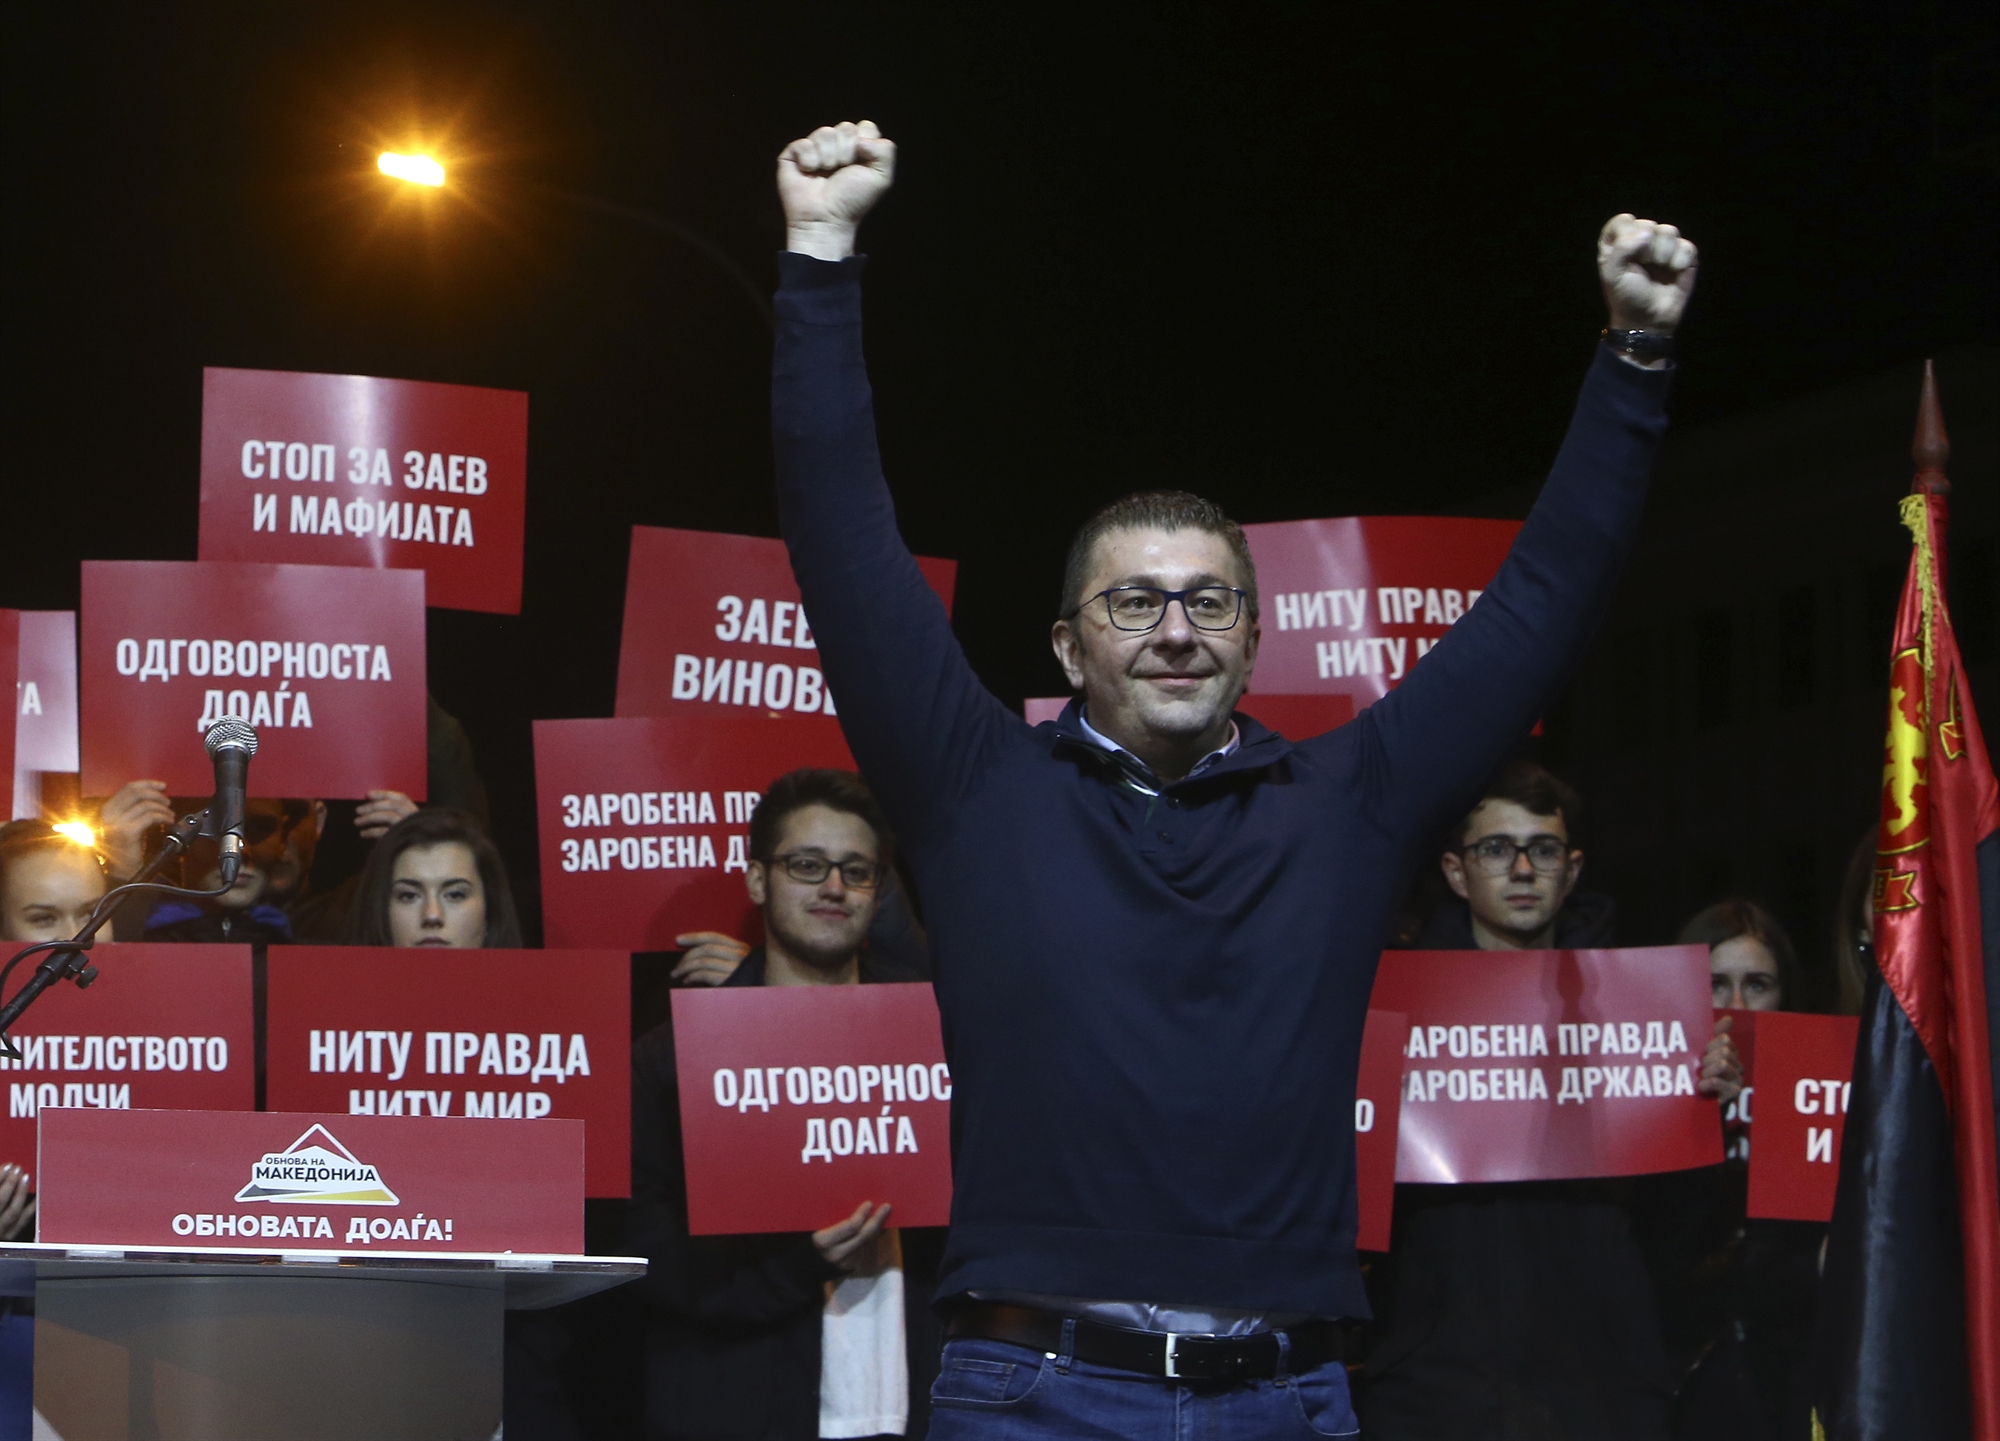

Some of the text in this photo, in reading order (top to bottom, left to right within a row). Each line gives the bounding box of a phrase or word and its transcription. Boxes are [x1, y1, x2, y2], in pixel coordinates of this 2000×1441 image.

[241, 439, 488, 496] СТОП ЗА ЗАЕВ
[252, 493, 474, 547] И МАФИЈАТА
[1275, 588, 1367, 631] НИТУ
[116, 638, 391, 682] ОДГОВОРНОСТА
[1316, 636, 1407, 680] НИТУ
[197, 681, 313, 733] ДОАЃА
[561, 791, 717, 828] ЗАРОБЕНА
[560, 835, 717, 873] ЗАРОБЕНА
[309, 1029, 591, 1084] НИТУ ПРАВДА
[1403, 1020, 1689, 1060] АРОБЕНА ПРАВДА
[713, 1062, 952, 1113] ОДГОВОРНОС
[1402, 1067, 1549, 1103] АРОБЕНА
[1556, 1063, 1695, 1105] ДРЖАВА
[801, 1104, 919, 1164] ДОАЃА
[1806, 1126, 1834, 1164] И
[255, 1166, 377, 1183] МАКЕДОНИЈА
[265, 1156, 326, 1166] ОБНОВА НА
[171, 1213, 454, 1244] ОБНОВАТА ДОАЃА!
